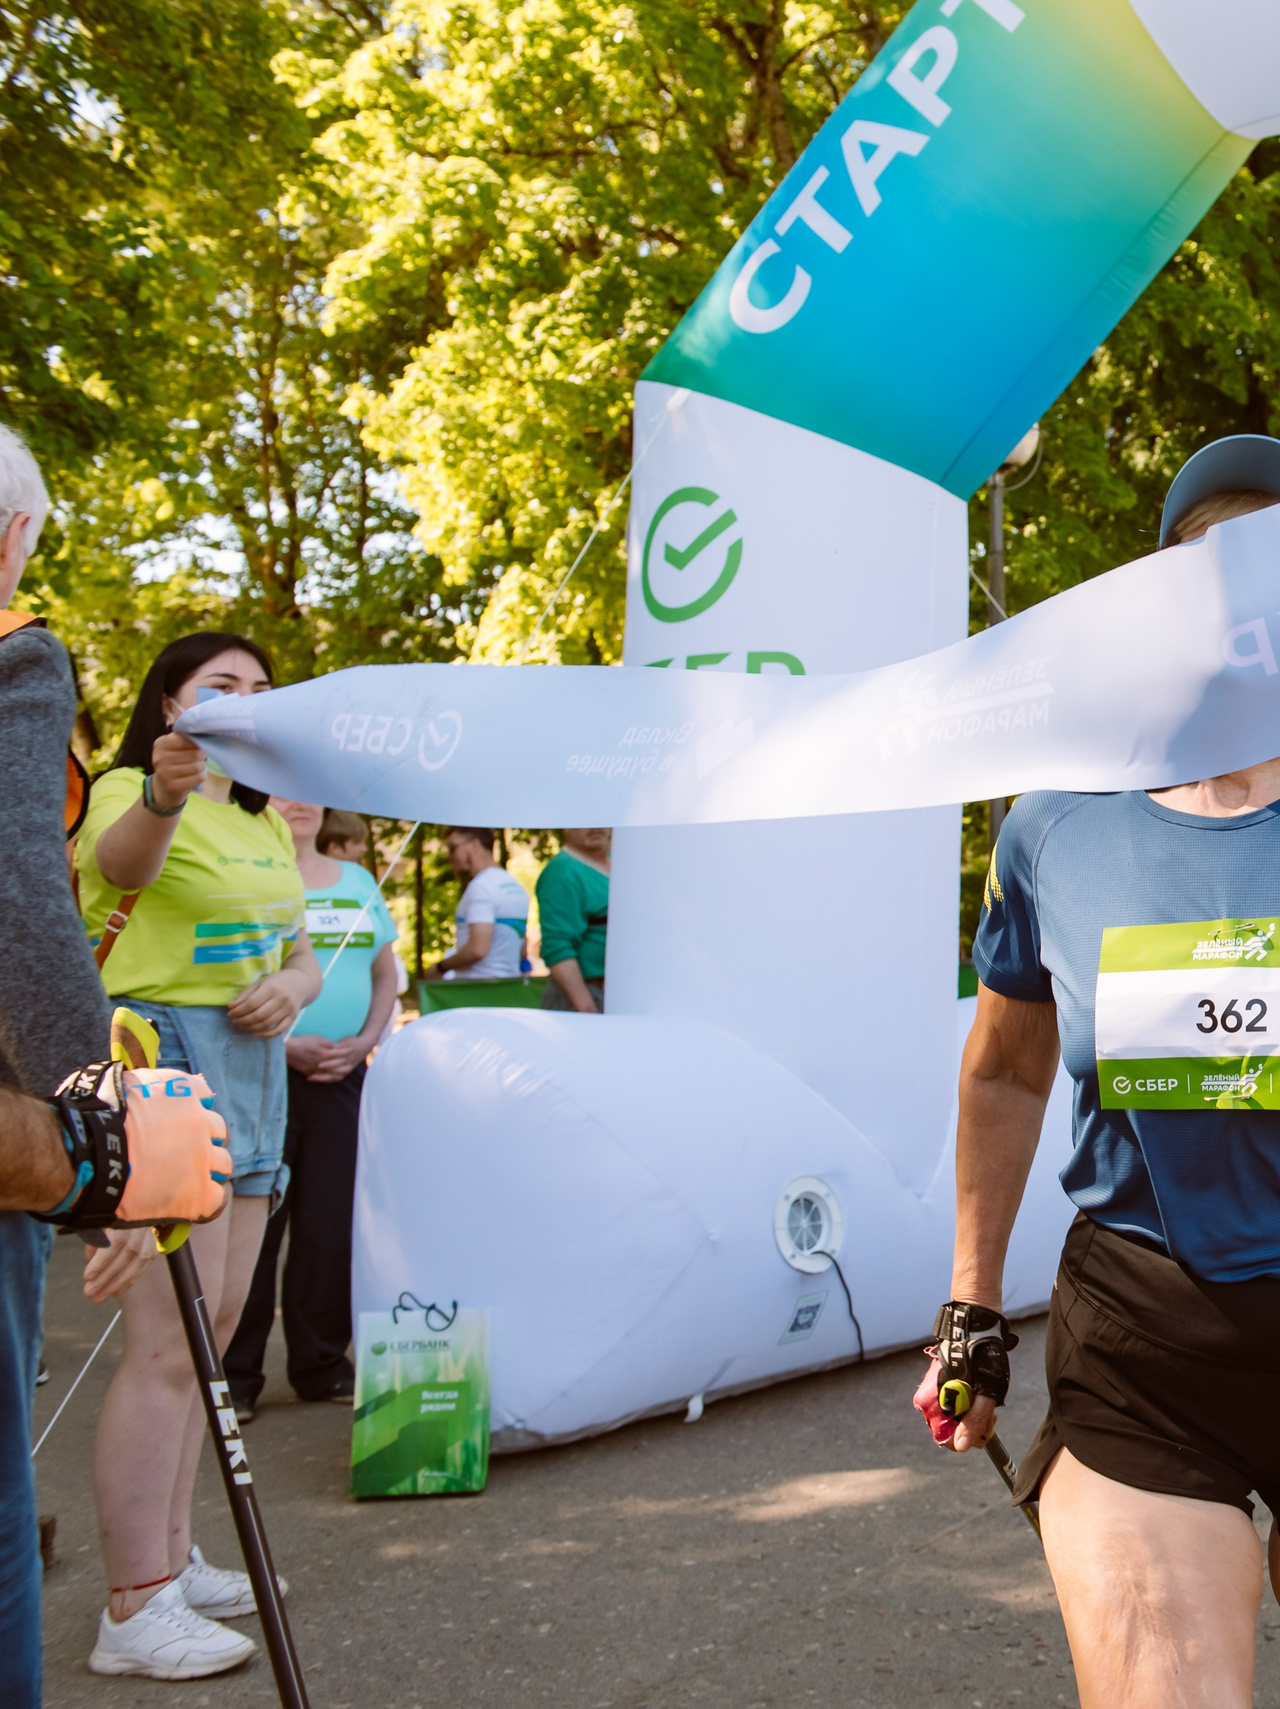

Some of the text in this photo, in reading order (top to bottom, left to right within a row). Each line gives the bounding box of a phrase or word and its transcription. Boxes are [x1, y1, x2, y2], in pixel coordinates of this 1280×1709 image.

[1197, 936, 1243, 949] ЗЕЛЁНЫЙ
[1192, 949, 1243, 960] МАРАФОН
[1196, 998, 1267, 1034] 362
[1204, 1073, 1240, 1081] ЗЕЛЁНЫЙ
[1135, 1078, 1179, 1092] СБЕР
[950, 1309, 966, 1359] LEKI
[421, 1390, 459, 1400] Всегда
[420, 1402, 456, 1413] рядом
[209, 1380, 253, 1485] LEKI
